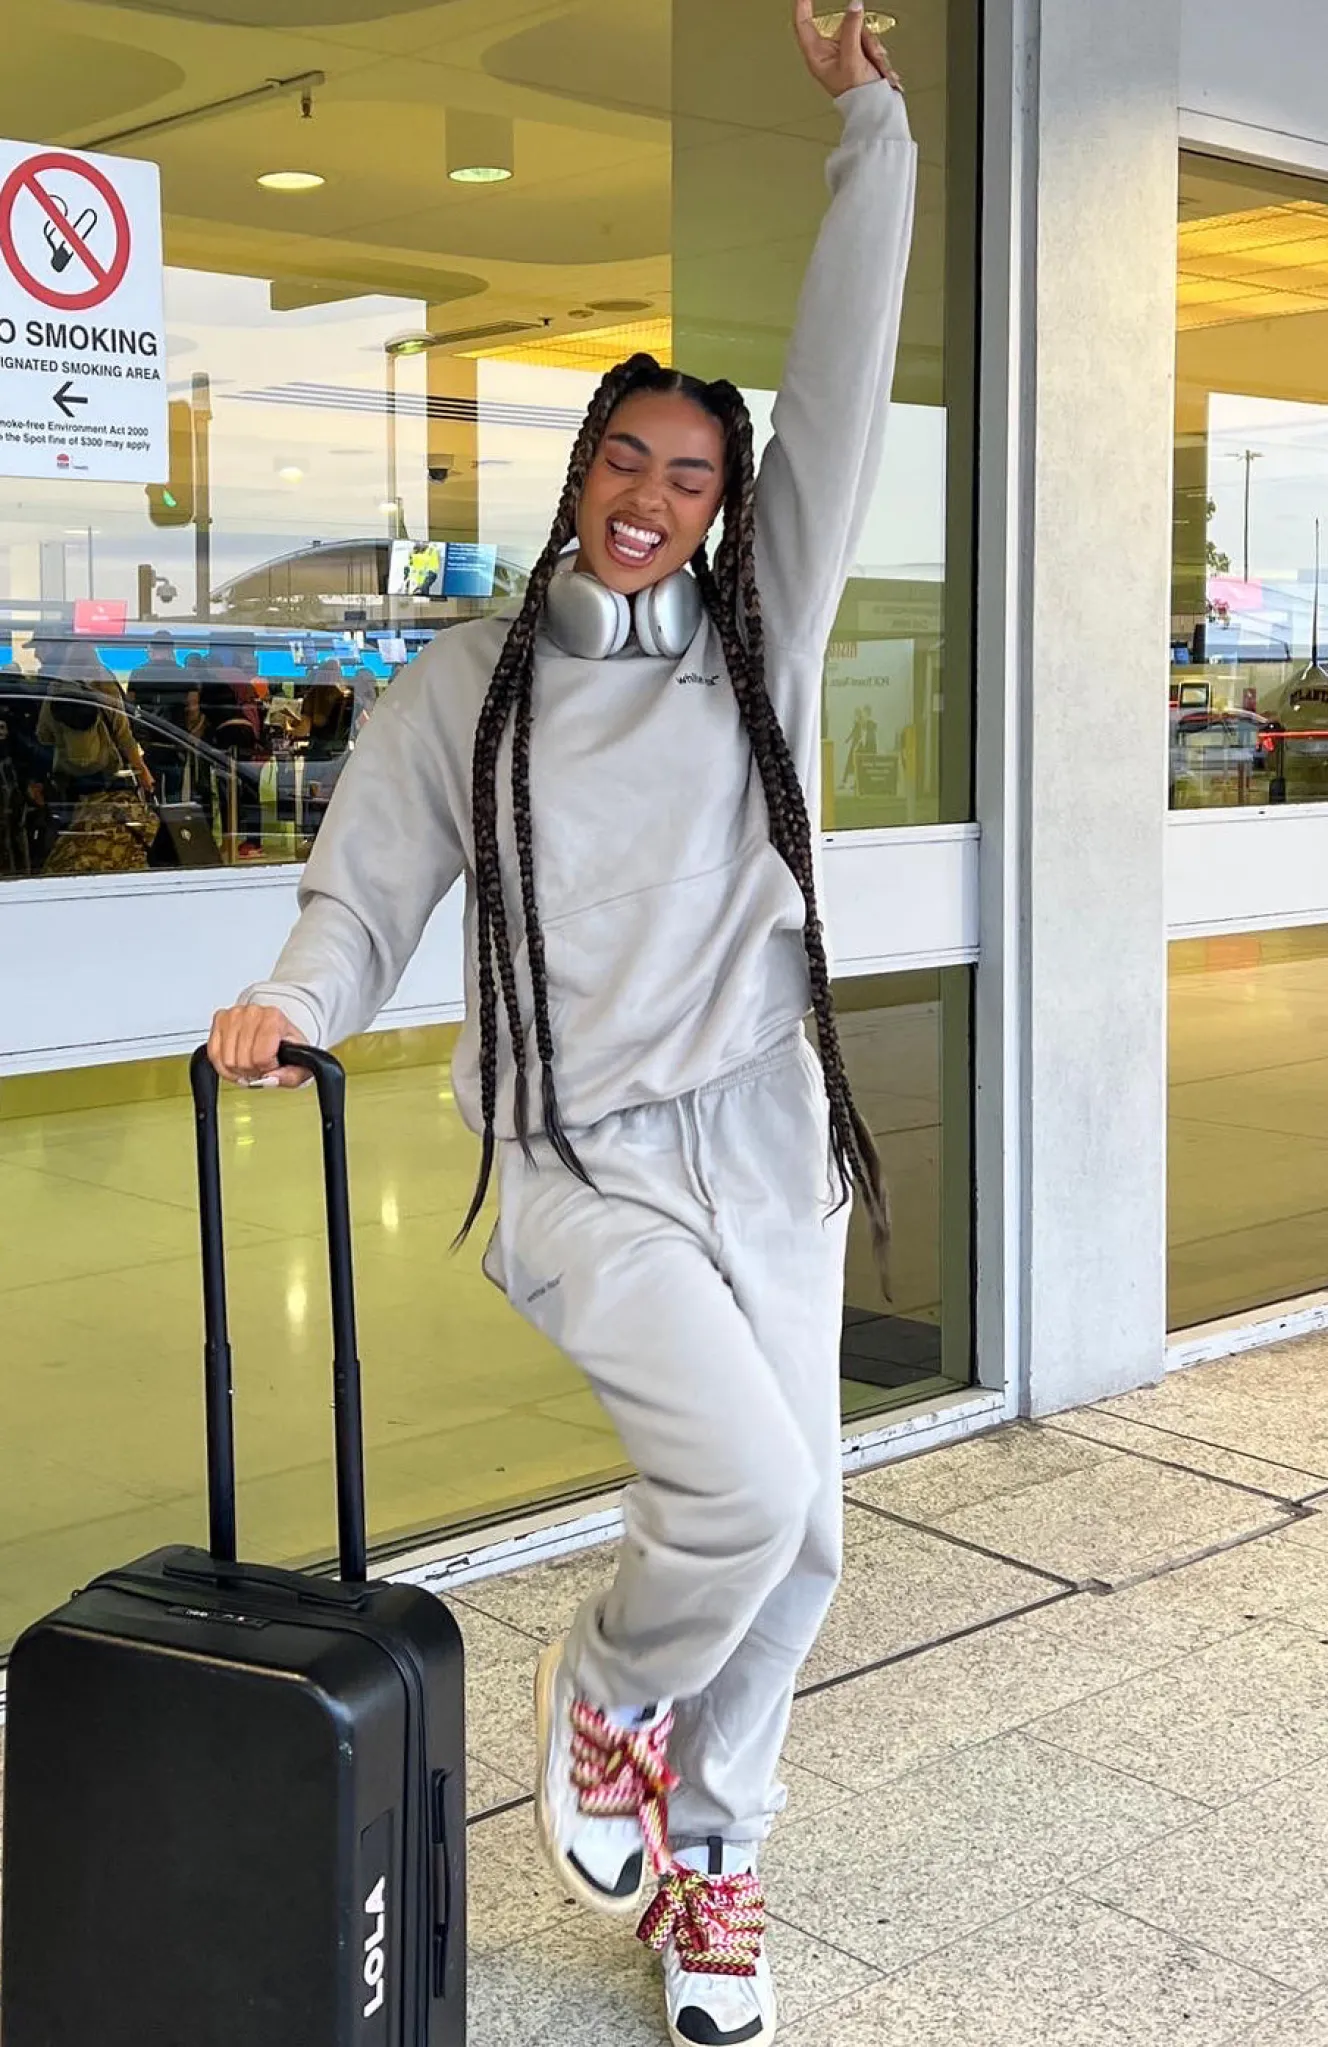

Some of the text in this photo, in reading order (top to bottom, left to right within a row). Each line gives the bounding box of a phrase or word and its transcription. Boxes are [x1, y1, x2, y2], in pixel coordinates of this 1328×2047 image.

[26, 321, 157, 356] SMOKING
[61, 361, 122, 378] SMOKING
[126, 366, 160, 381] AREA
[48, 421, 107, 435] Environment
[109, 425, 125, 436] Act
[128, 426, 149, 437] 2000
[5, 431, 21, 442] the
[23, 432, 46, 445] Spot
[68, 436, 78, 446] of
[104, 440, 124, 451] may
[126, 440, 151, 452] apply
[363, 1874, 386, 2019] LOLA
